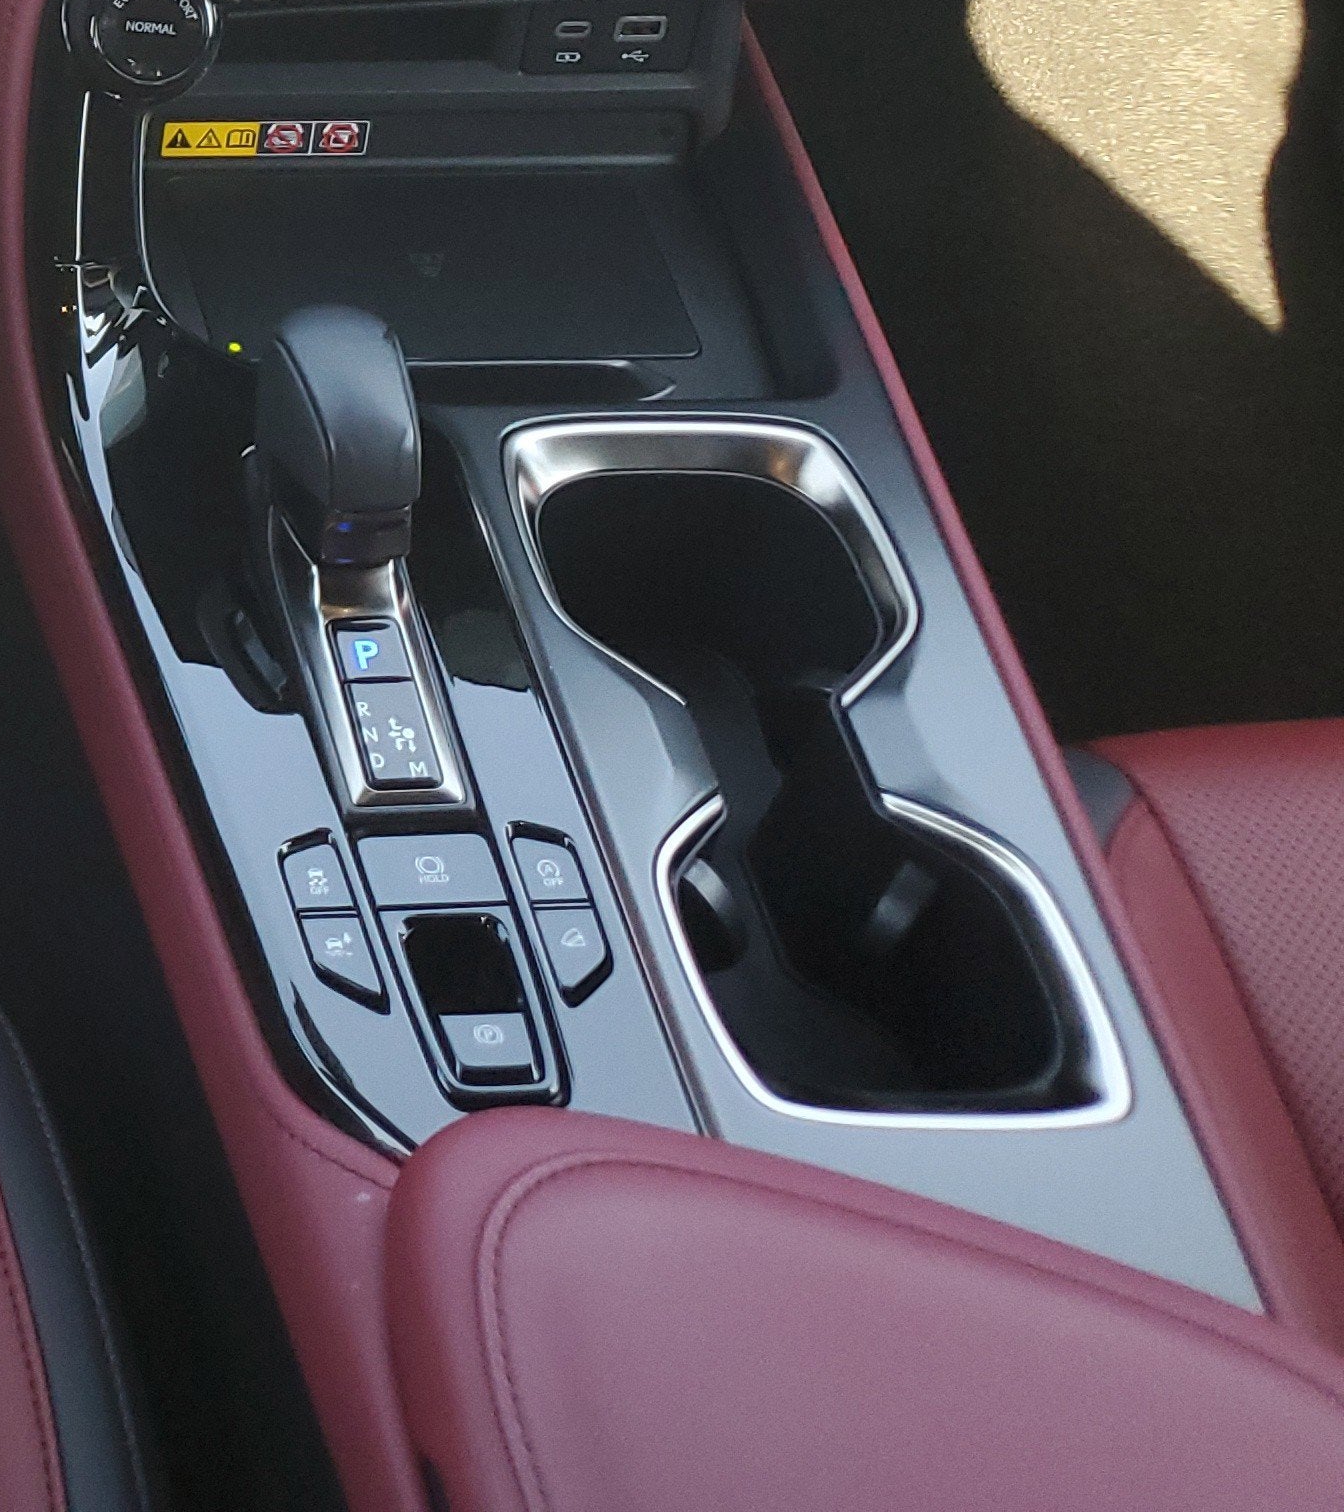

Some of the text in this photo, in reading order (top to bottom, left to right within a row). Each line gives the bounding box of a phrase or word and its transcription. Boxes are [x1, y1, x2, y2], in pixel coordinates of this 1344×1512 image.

[125, 20, 177, 36] NORMAL
[353, 639, 379, 669] P
[357, 701, 372, 717] R
[363, 726, 379, 742] N
[370, 753, 385, 769] D
[409, 761, 428, 777] M
[420, 874, 449, 884] HOLD
[542, 877, 564, 887] OFF
